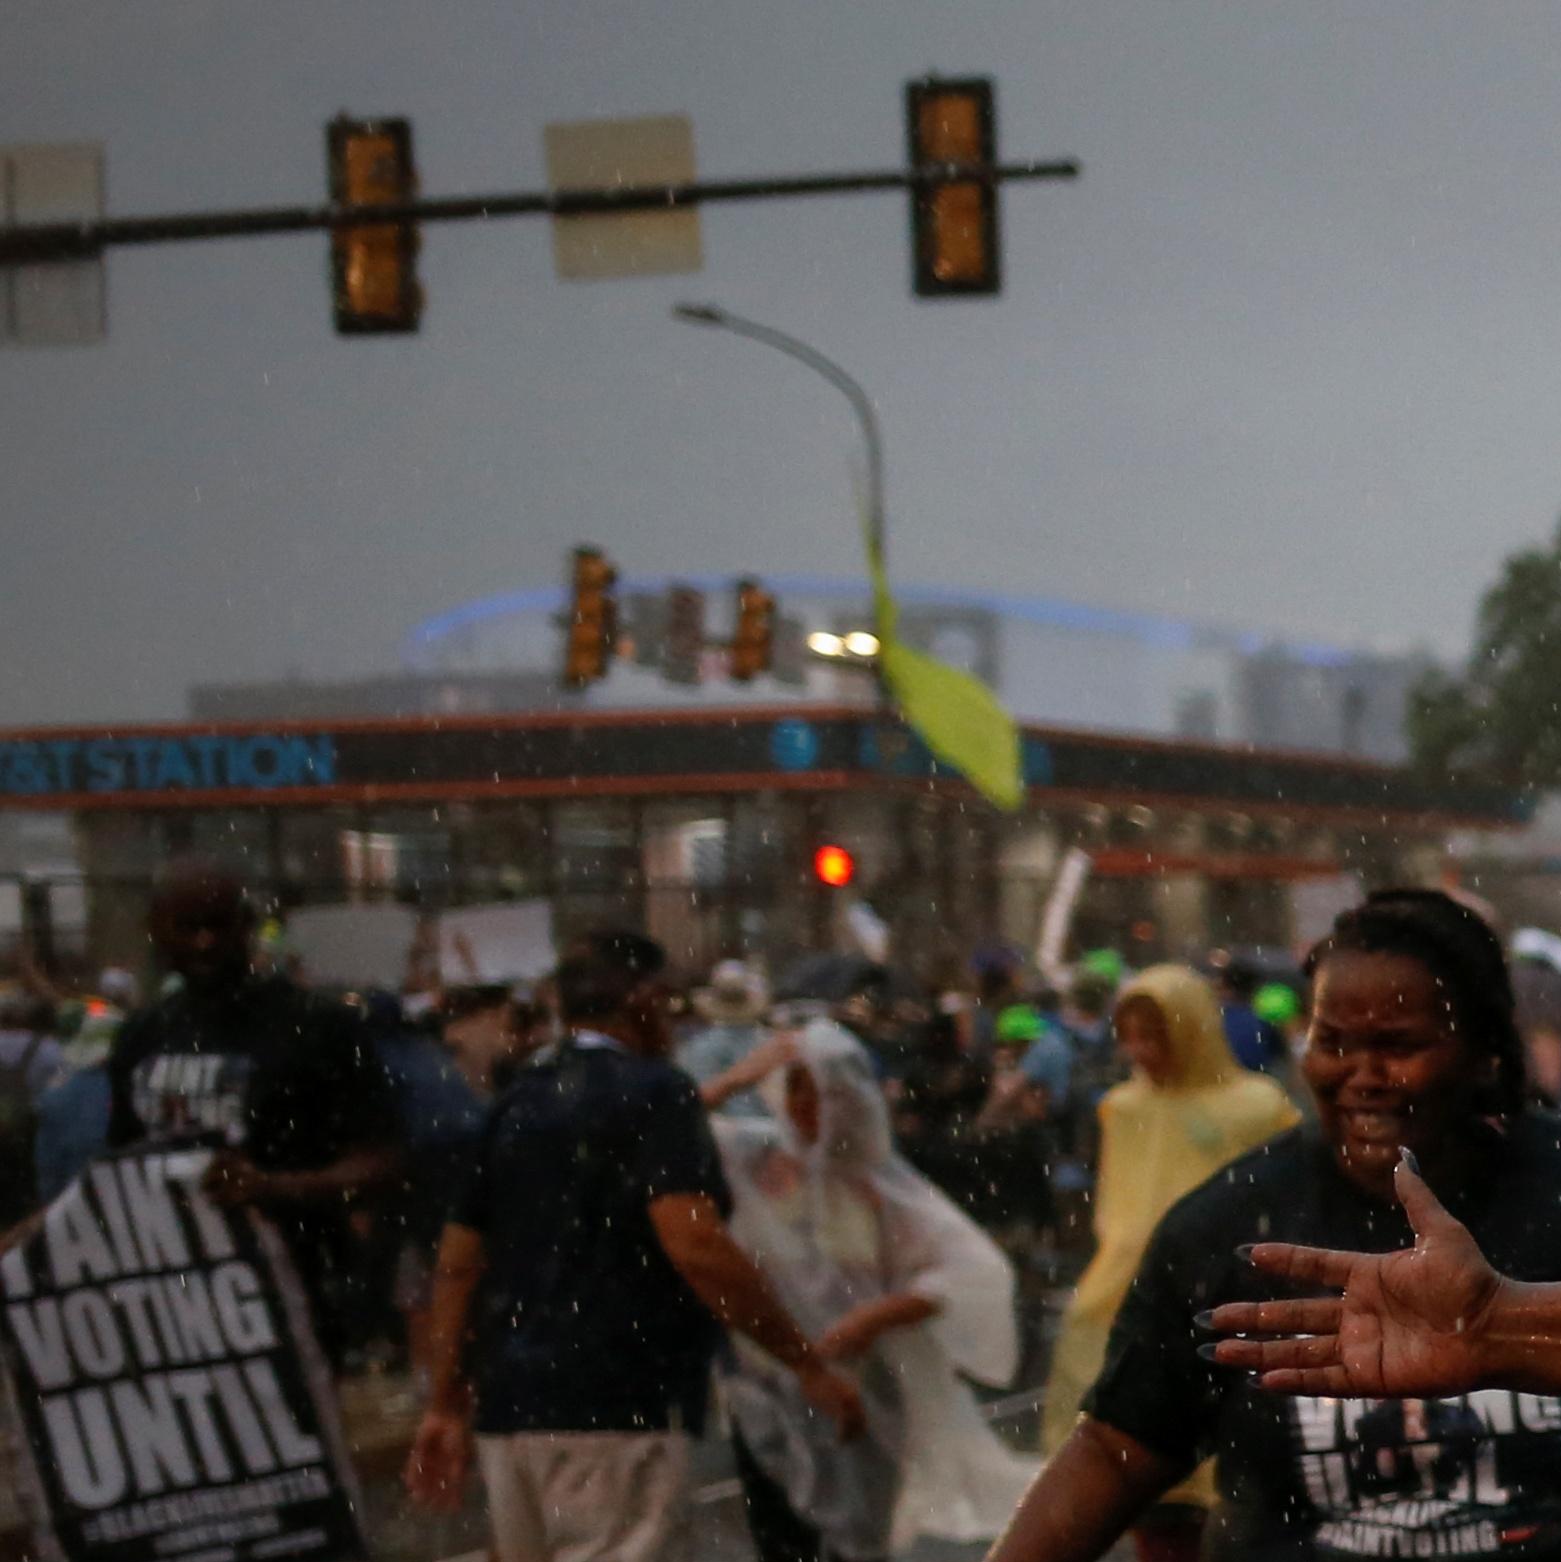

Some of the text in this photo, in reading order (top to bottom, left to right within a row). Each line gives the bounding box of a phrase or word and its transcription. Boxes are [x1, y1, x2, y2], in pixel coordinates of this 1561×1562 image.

[87, 735, 337, 790] STATION
[45, 1151, 236, 1288] AINT
[6, 1260, 277, 1391] VOTING
[43, 1357, 322, 1511] UNTIL
